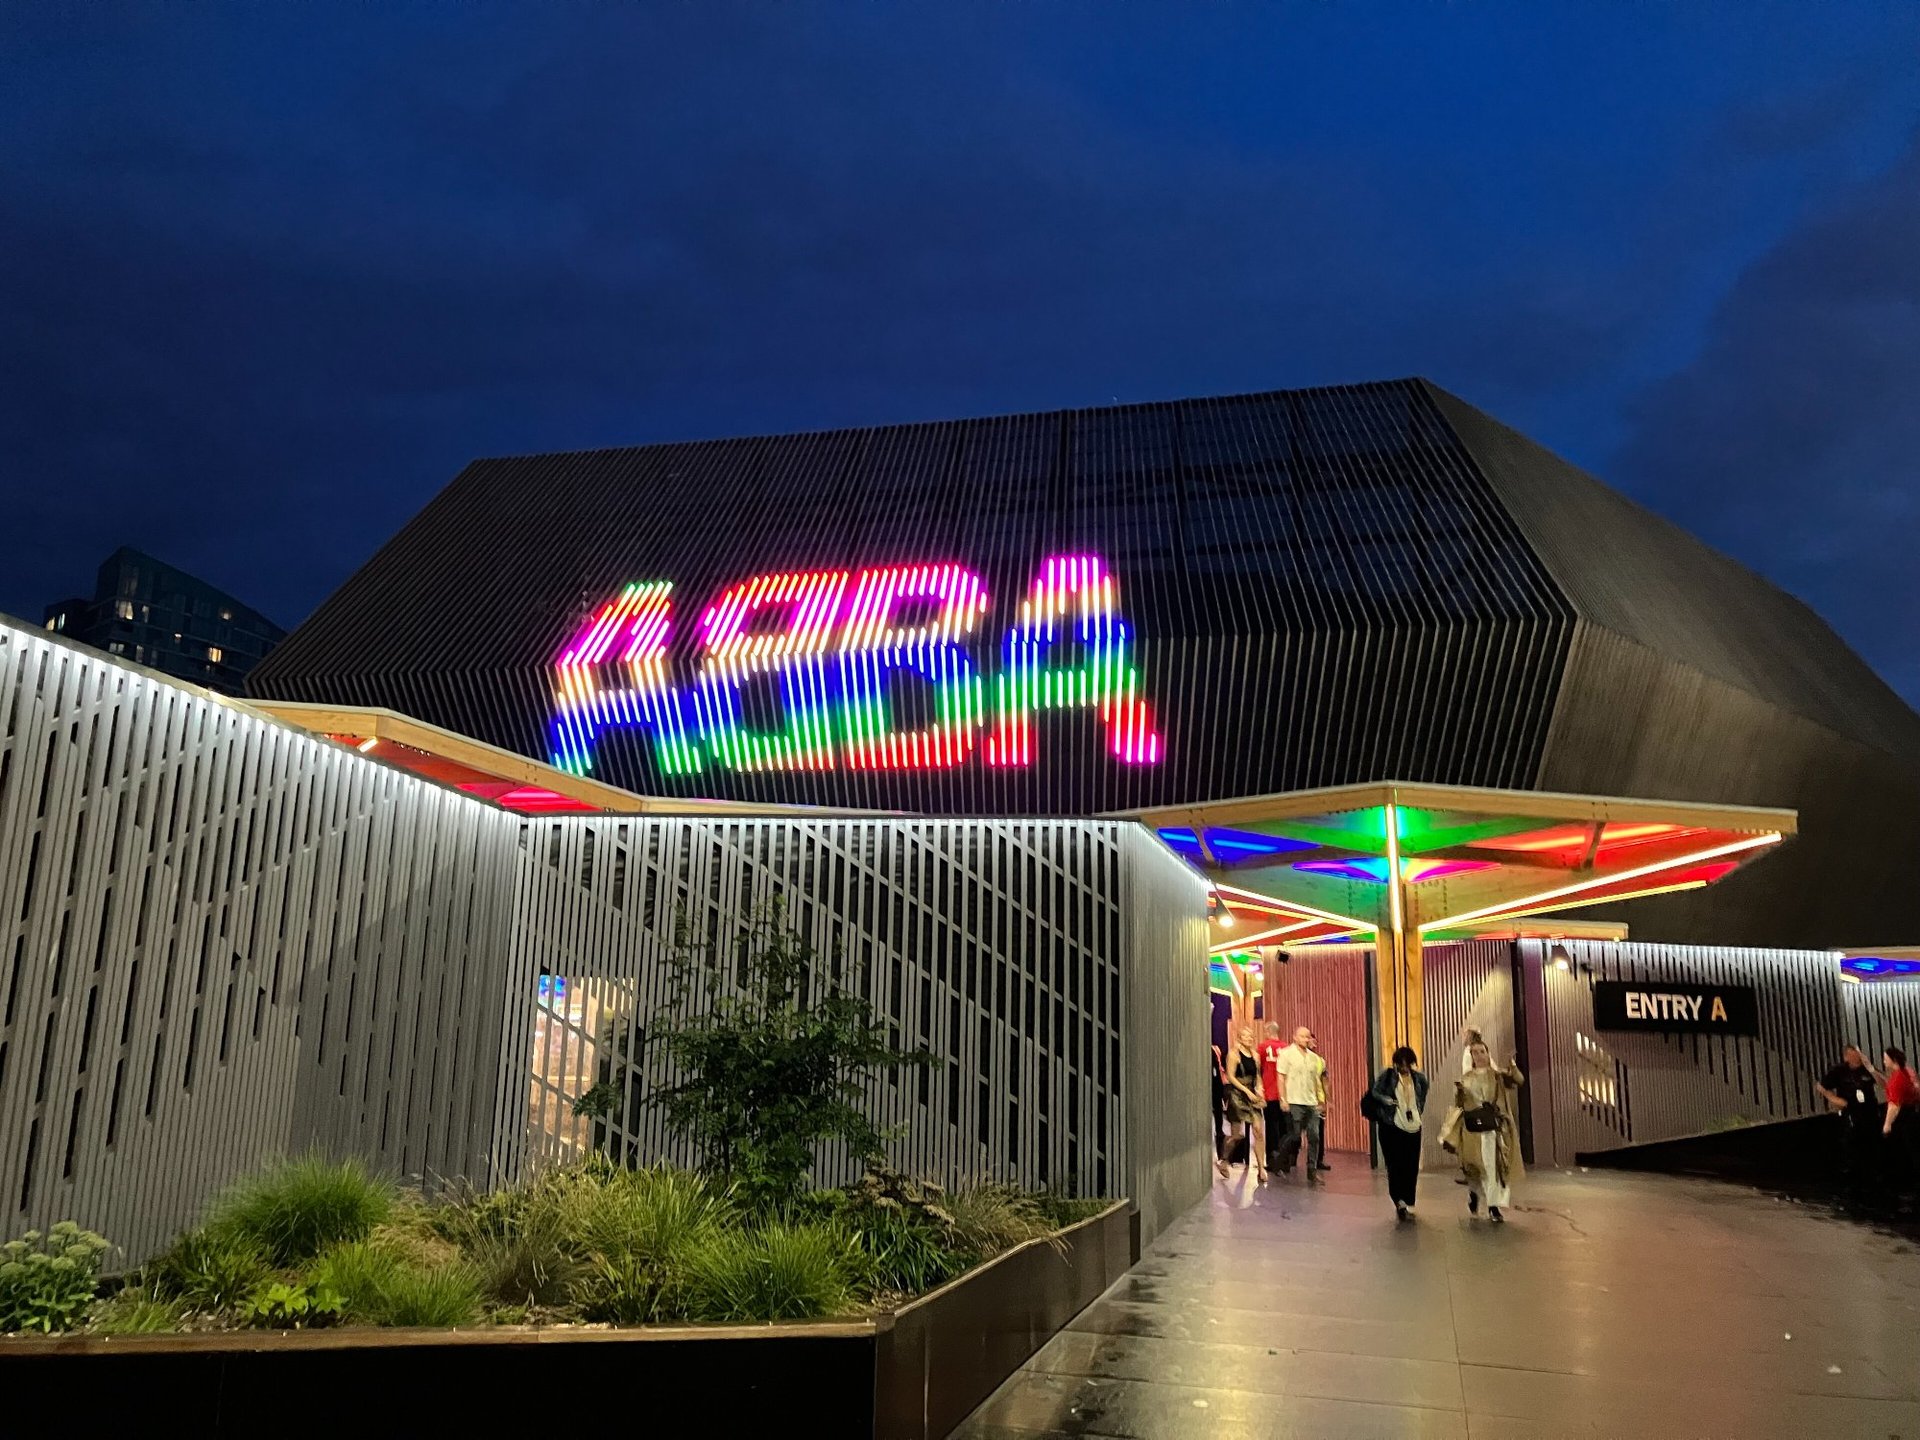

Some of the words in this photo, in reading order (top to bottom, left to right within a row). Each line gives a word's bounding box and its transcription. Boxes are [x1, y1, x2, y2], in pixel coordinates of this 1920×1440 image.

[553, 555, 1160, 774] ABBA
[1625, 991, 1702, 1021] ENTRY
[1711, 996, 1728, 1022] A
